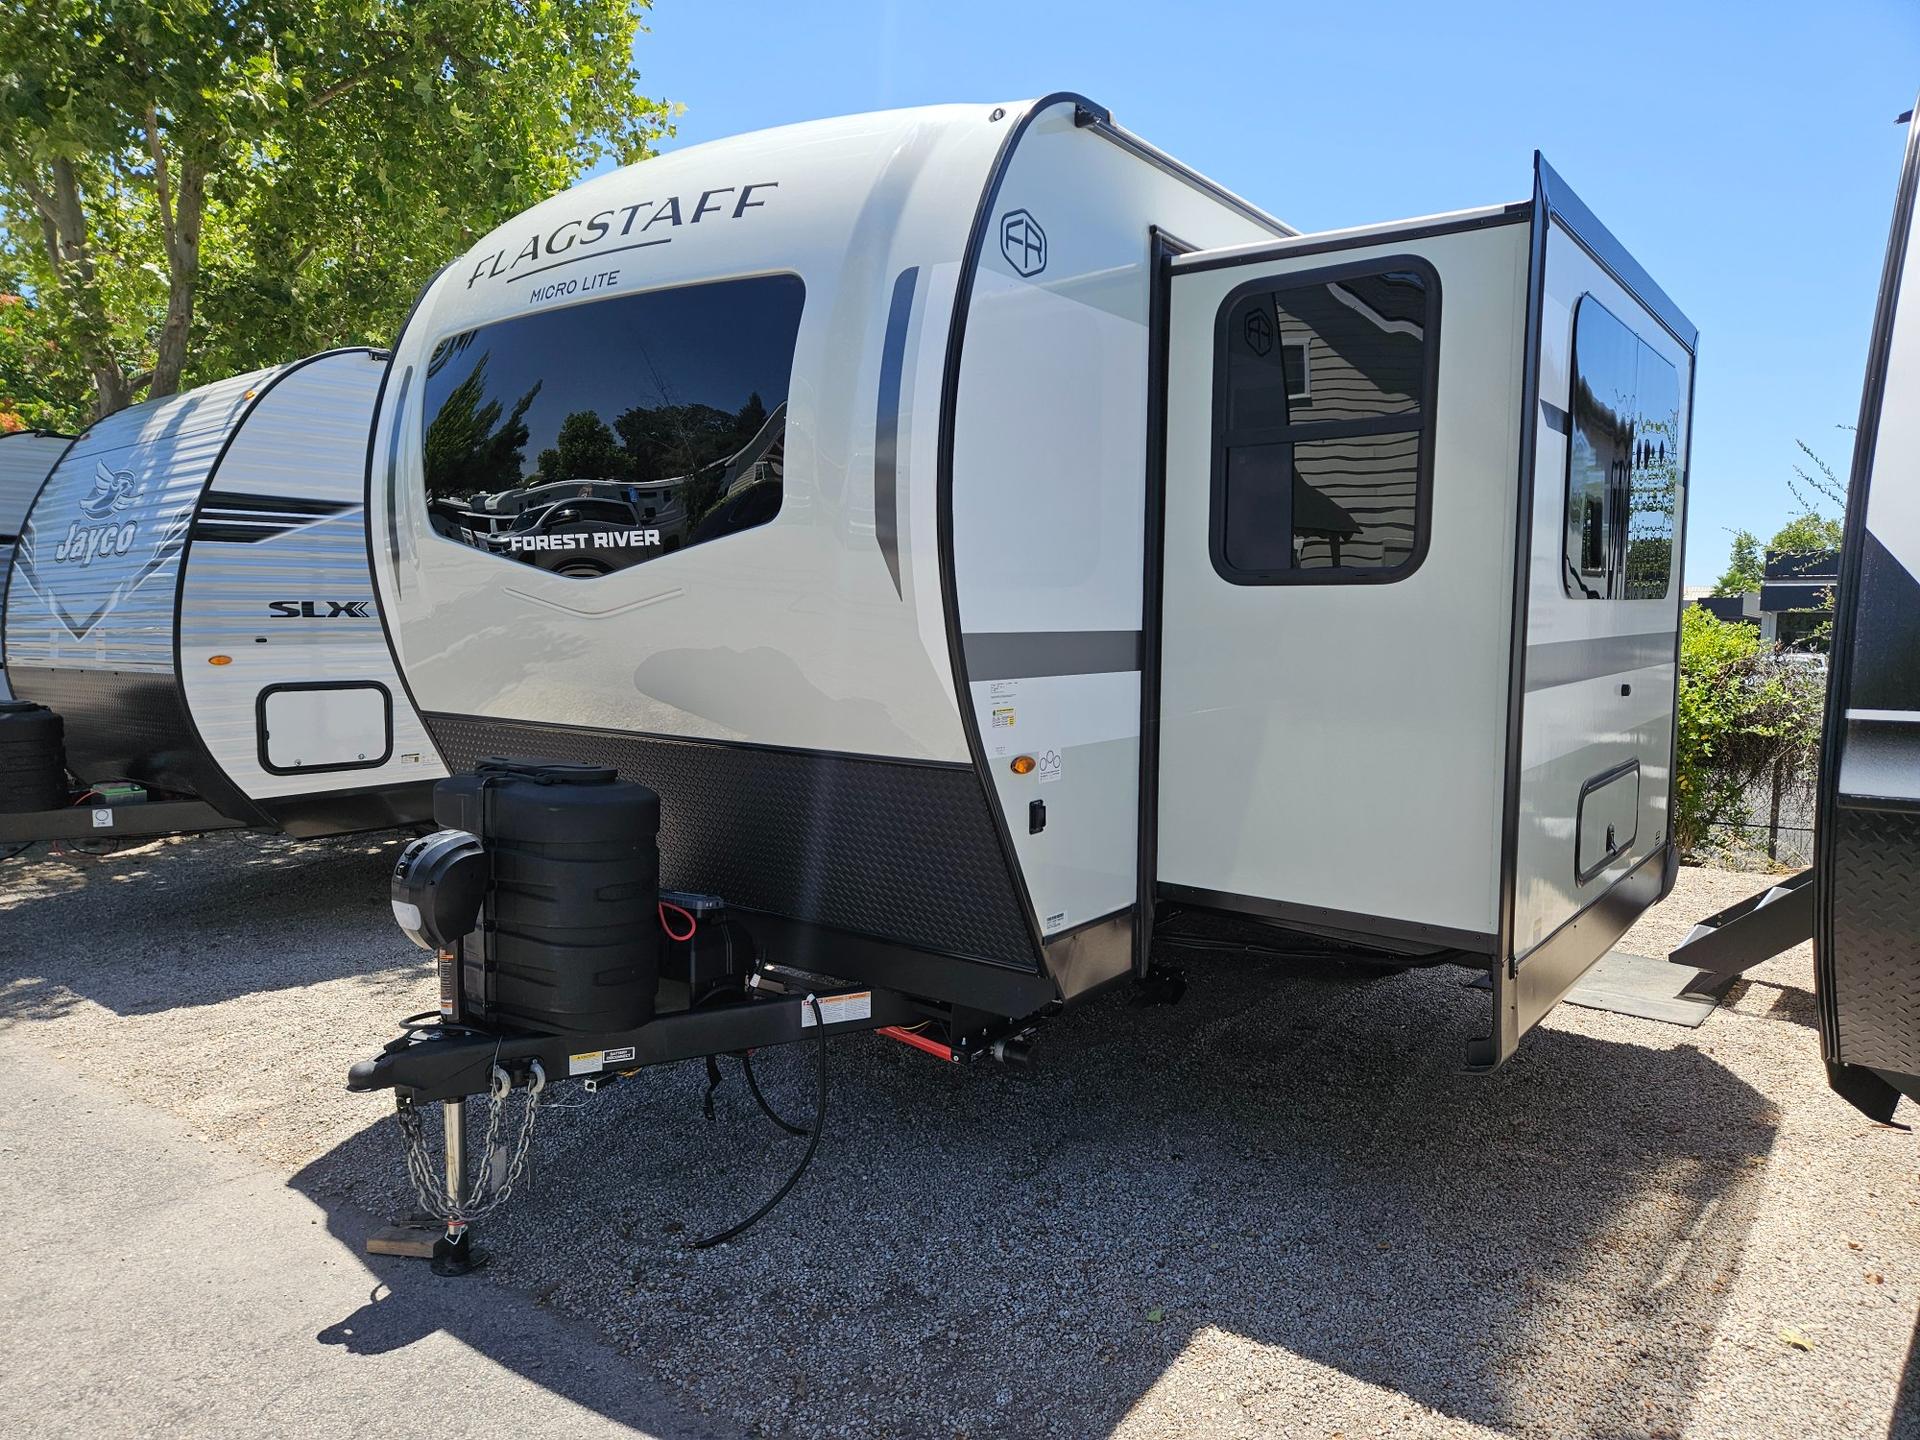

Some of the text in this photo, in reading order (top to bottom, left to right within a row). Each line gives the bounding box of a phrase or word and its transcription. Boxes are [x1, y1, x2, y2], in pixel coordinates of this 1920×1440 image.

[466, 181, 779, 290] FLAGSTAFF
[529, 270, 620, 304] MICRO LITE
[55, 519, 137, 568] Jayco
[510, 529, 661, 552] FOREST RIVER
[268, 600, 370, 618] SLX
